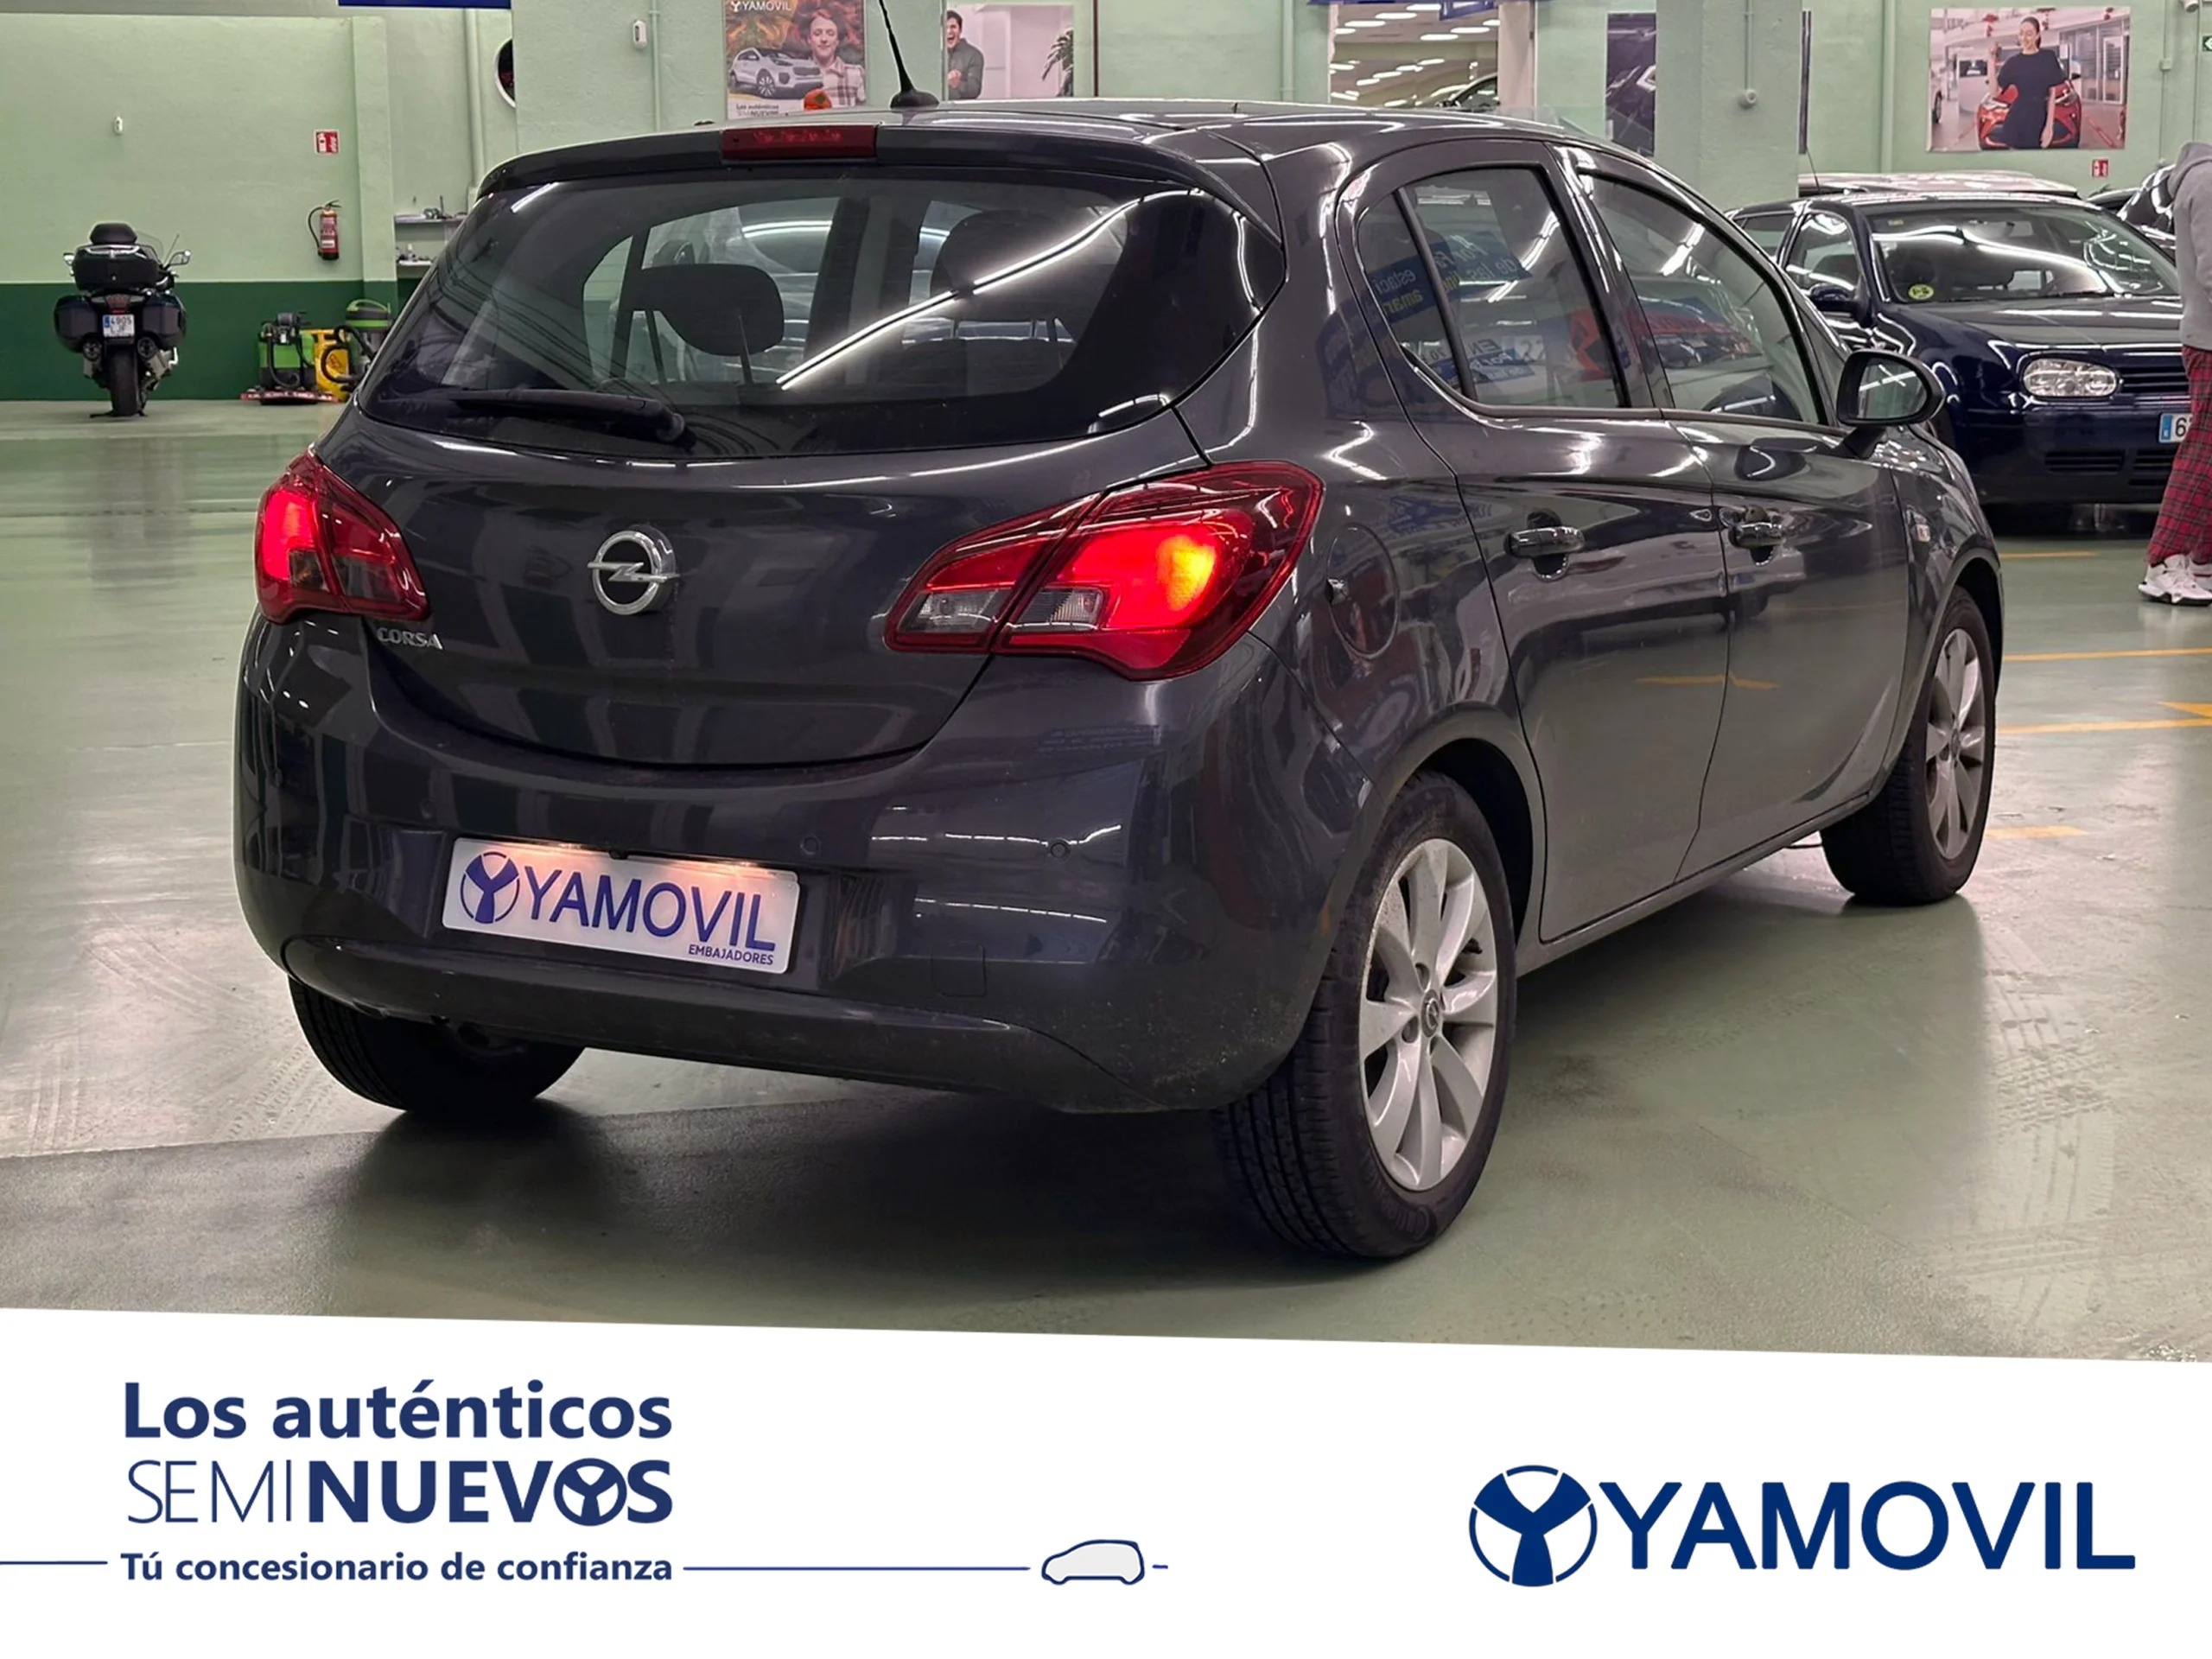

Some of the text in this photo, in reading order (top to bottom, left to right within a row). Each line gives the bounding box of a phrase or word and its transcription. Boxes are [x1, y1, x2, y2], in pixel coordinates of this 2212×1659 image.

[742, 1, 791, 11] YAMOVIL
[2175, 416, 2192, 437] 6
[377, 626, 443, 650] CORSA
[524, 864, 776, 951] YAMOVIL
[688, 944, 774, 966] EMBAJADORES
